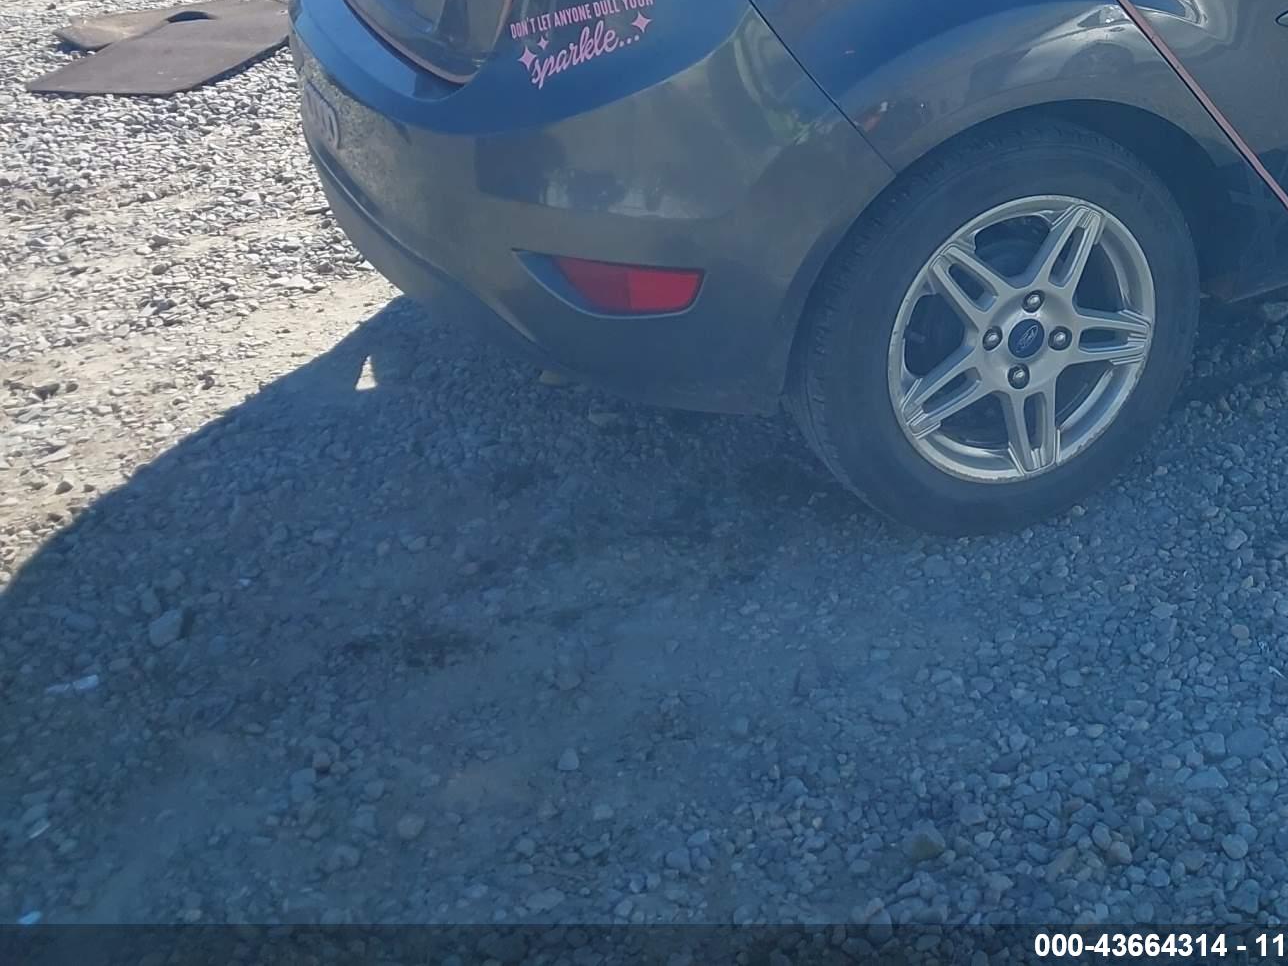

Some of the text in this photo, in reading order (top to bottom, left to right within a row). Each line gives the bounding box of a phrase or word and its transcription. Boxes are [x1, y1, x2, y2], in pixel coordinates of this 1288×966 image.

[510, 17, 536, 39] DON'T
[537, 14, 552, 32] LET
[553, 4, 592, 27] ANYONE
